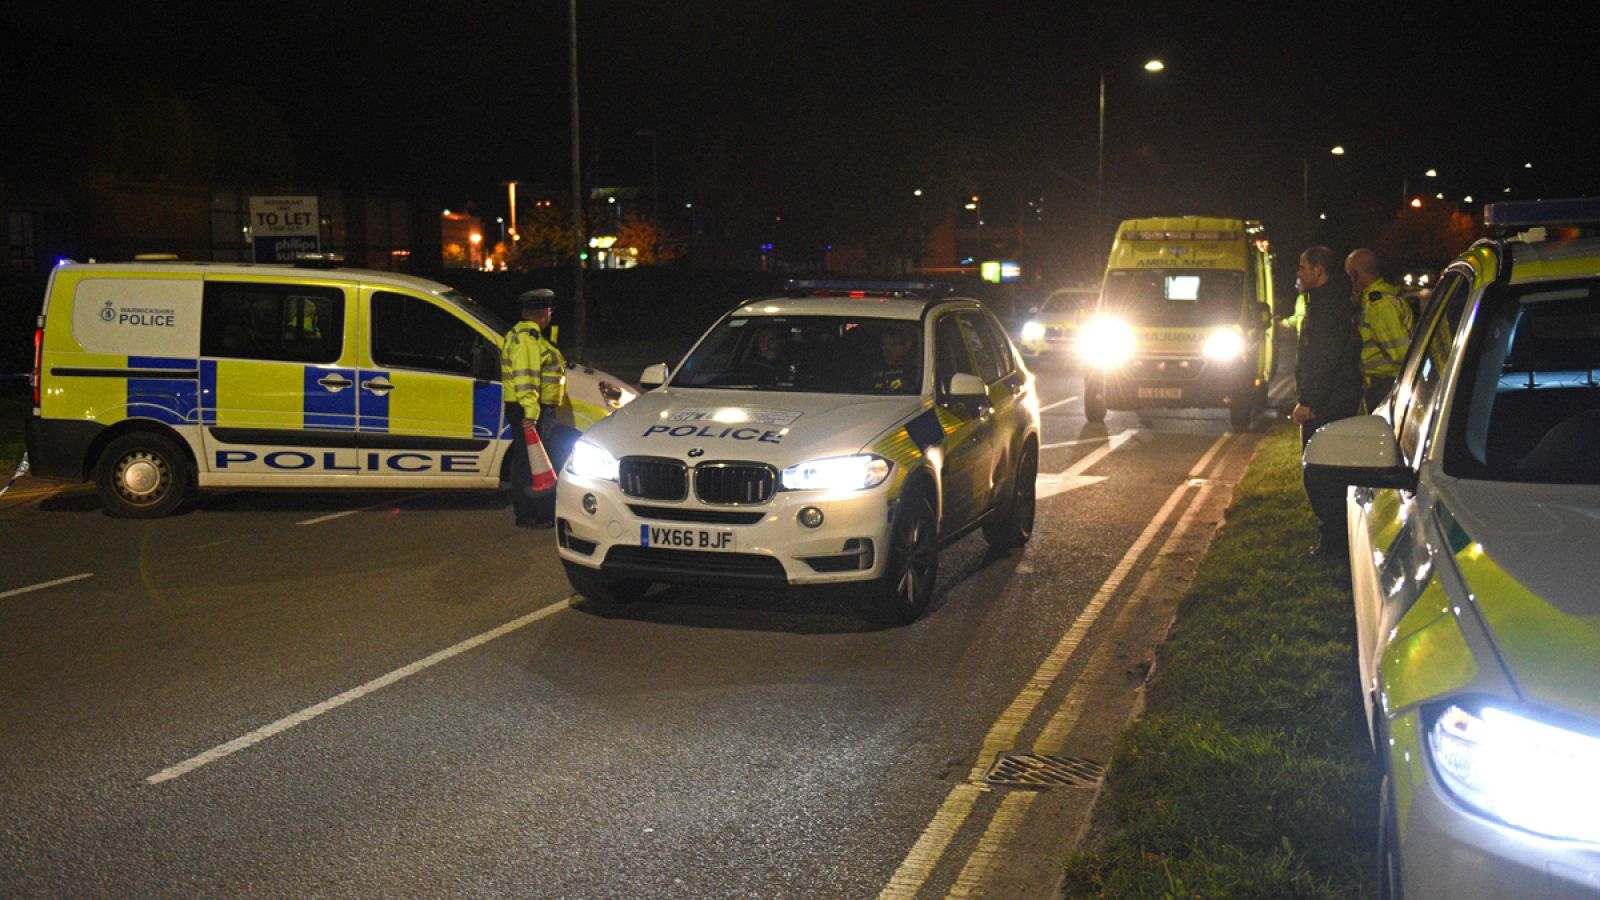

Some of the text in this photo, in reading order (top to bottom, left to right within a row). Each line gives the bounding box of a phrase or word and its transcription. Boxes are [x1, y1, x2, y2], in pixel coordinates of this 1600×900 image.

[256, 212, 312, 225] TO LET
[276, 239, 315, 251] phillips
[1136, 259, 1217, 267] AMBULANCE
[120, 307, 175, 315] WARWICKSHIRE
[119, 315, 175, 327] POLICE
[642, 424, 784, 444] POLICE
[215, 450, 481, 473] POLICE
[651, 528, 733, 549] VX66 BJF
